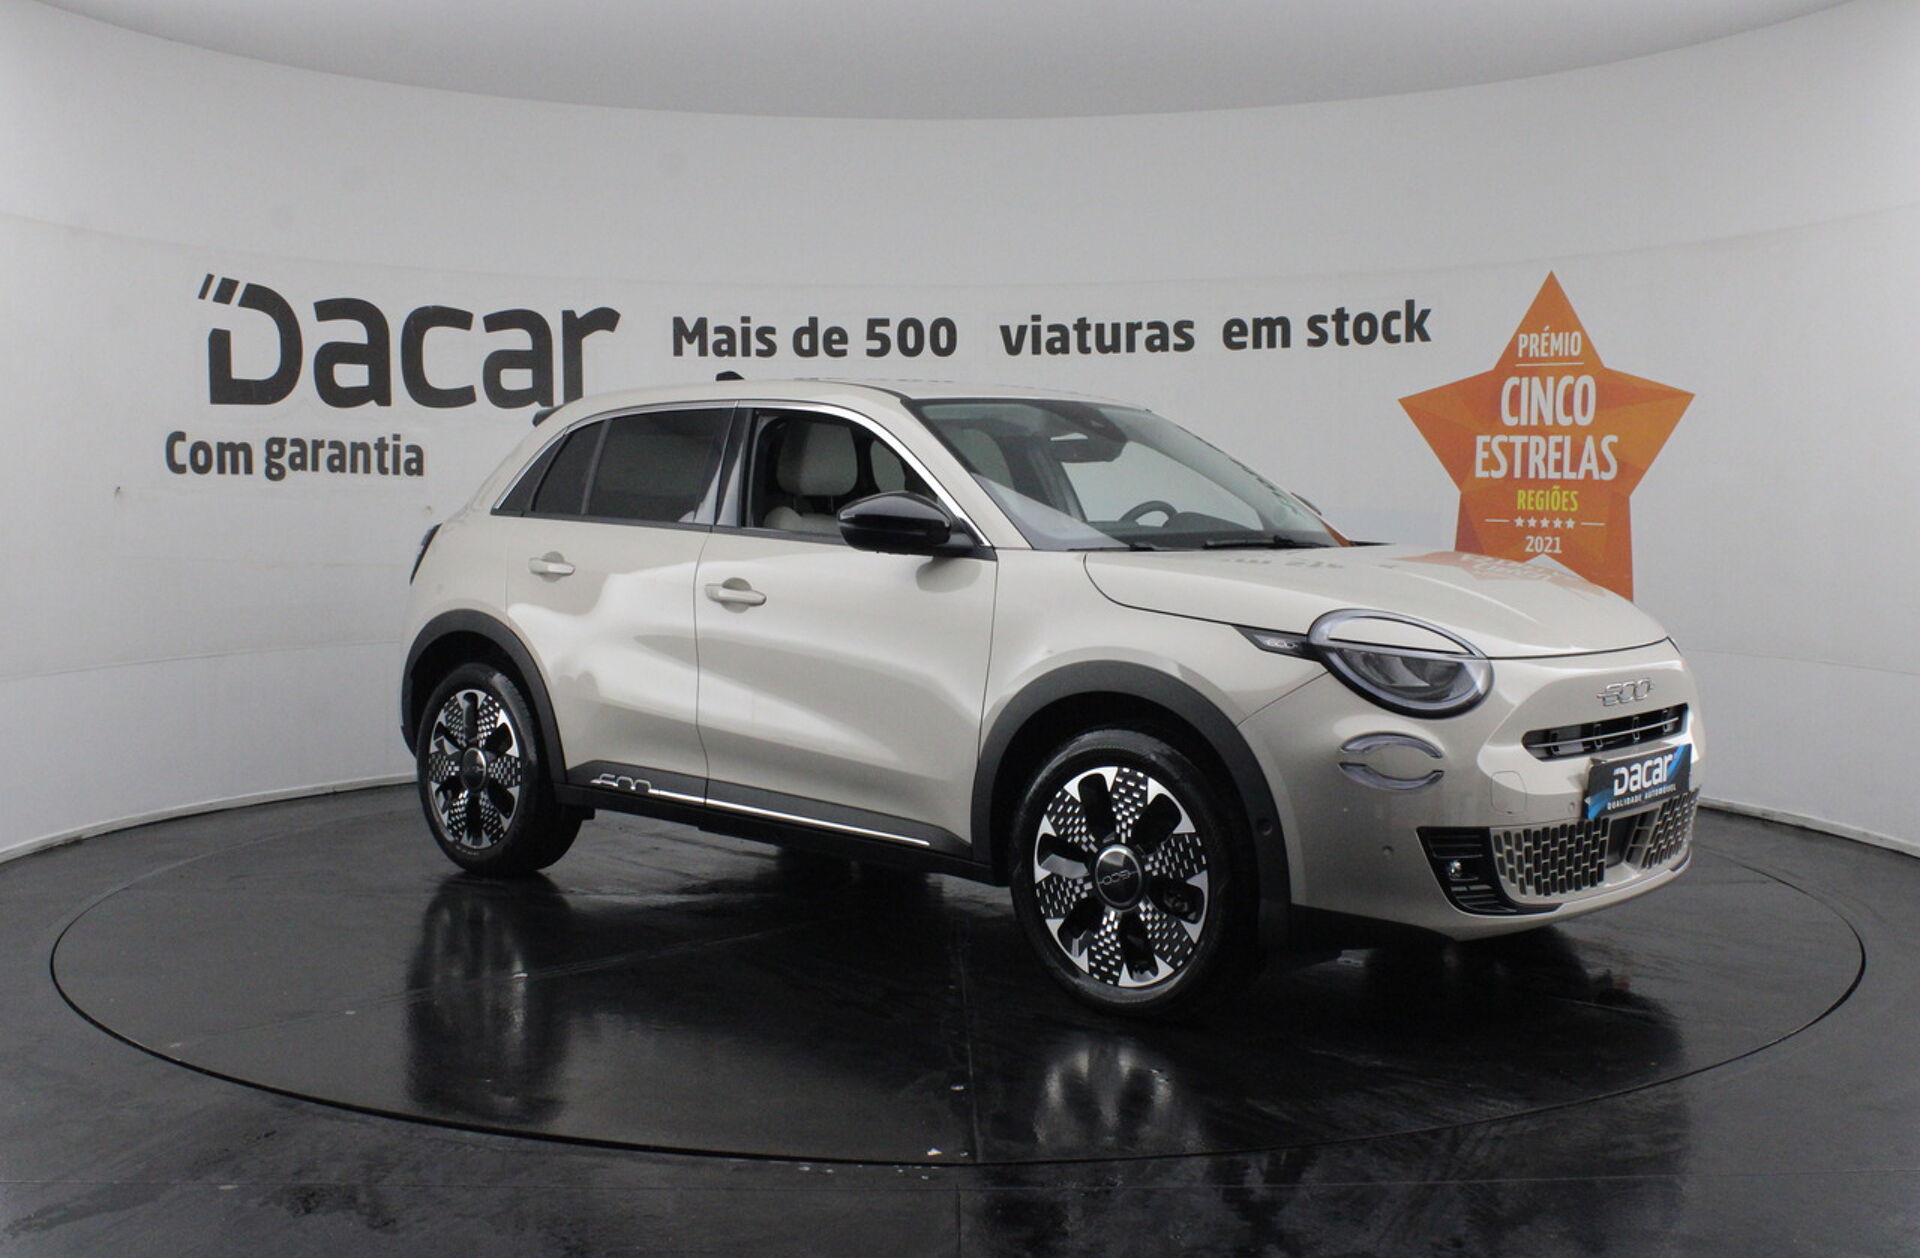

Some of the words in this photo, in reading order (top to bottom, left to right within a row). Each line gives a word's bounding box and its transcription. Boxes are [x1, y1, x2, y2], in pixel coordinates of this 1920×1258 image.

[197, 273, 621, 409] Dacar
[672, 315, 778, 358] Mais
[792, 316, 849, 358] de
[866, 317, 958, 358] 500
[1000, 314, 1195, 356] viaturas
[1222, 316, 1292, 350] em
[1306, 299, 1432, 348] stock
[1517, 325, 1583, 358] PRÉMIO
[1501, 375, 1596, 426] CINCO
[165, 431, 254, 475] Com
[264, 433, 425, 482] garantia
[1474, 434, 1619, 481] ESTRELAS
[1516, 485, 1580, 512] REGIÕES
[1524, 535, 1563, 554] 2021
[1613, 754, 1673, 796] Dacar
